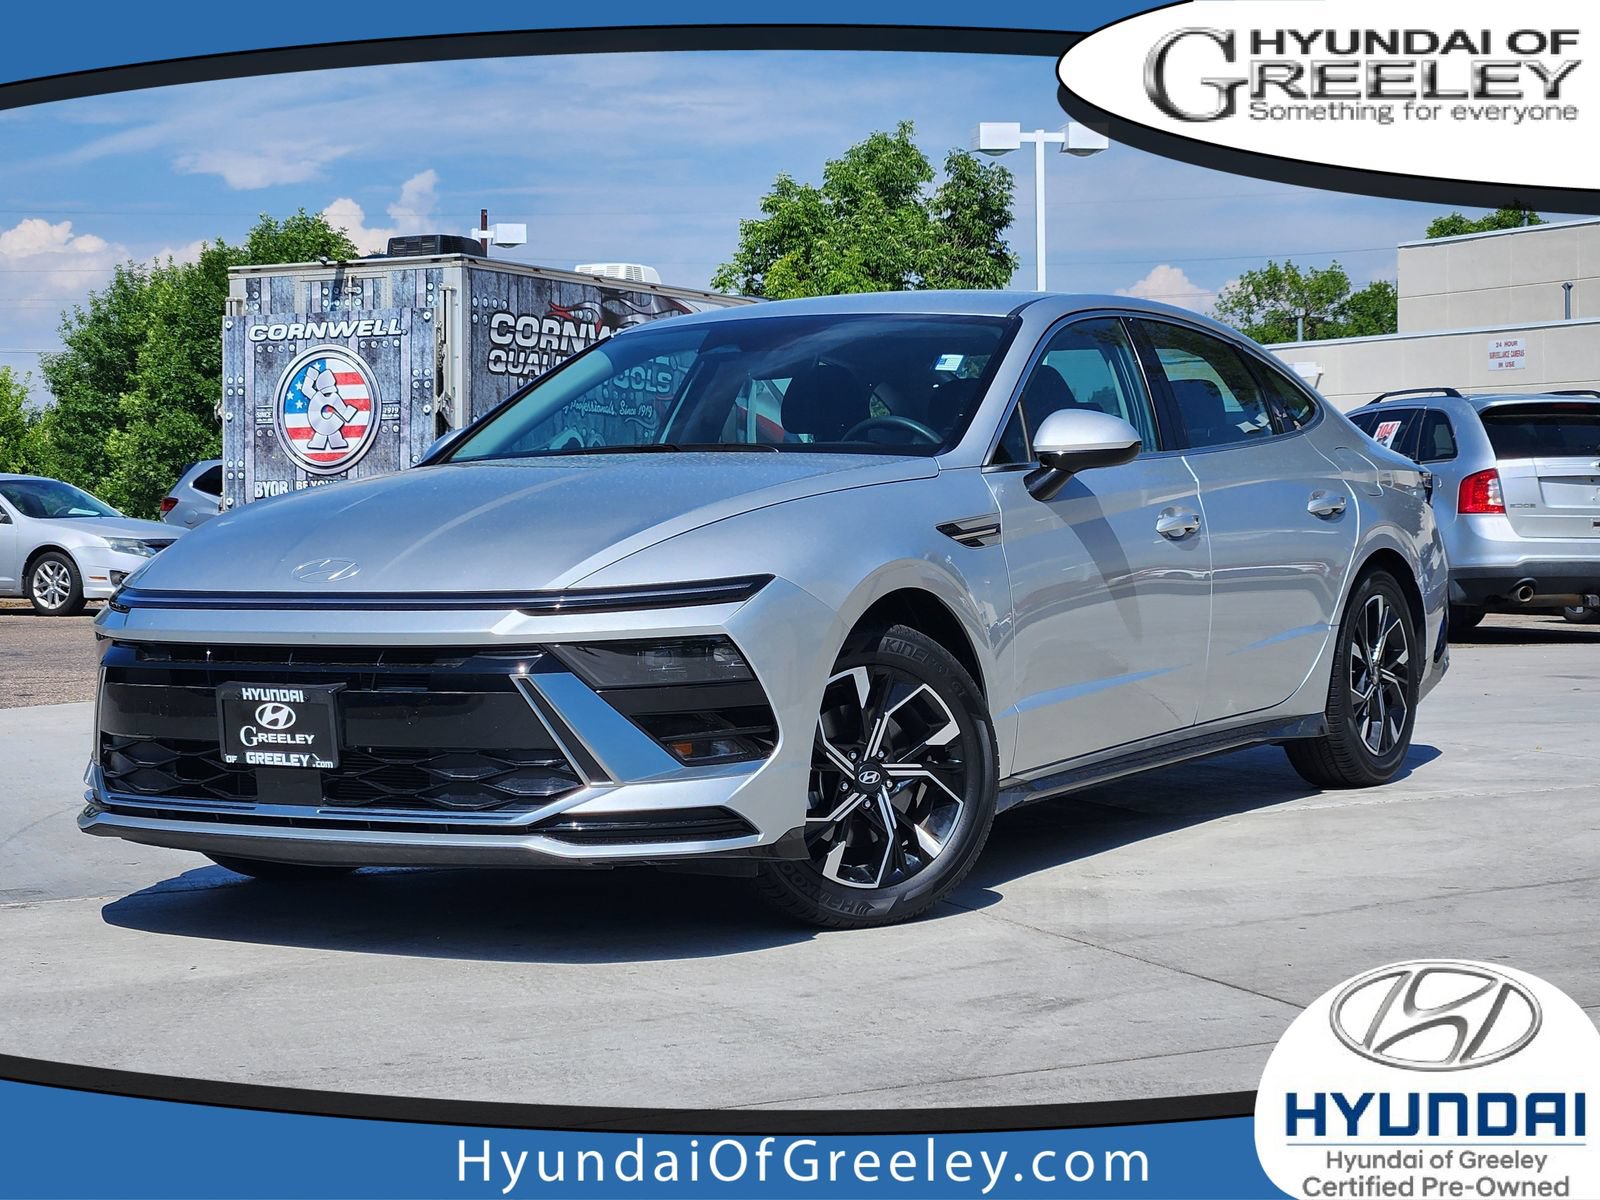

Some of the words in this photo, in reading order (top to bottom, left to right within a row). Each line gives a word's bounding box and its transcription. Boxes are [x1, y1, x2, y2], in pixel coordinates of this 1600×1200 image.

[249, 319, 402, 341] CORNWELL
[604, 366, 672, 393] OOLS
[254, 480, 288, 498] BYOR
[241, 687, 305, 703] HYUNDAI
[240, 725, 315, 747] GREELEY
[225, 754, 238, 764] OF
[245, 751, 310, 767] GREELEY
